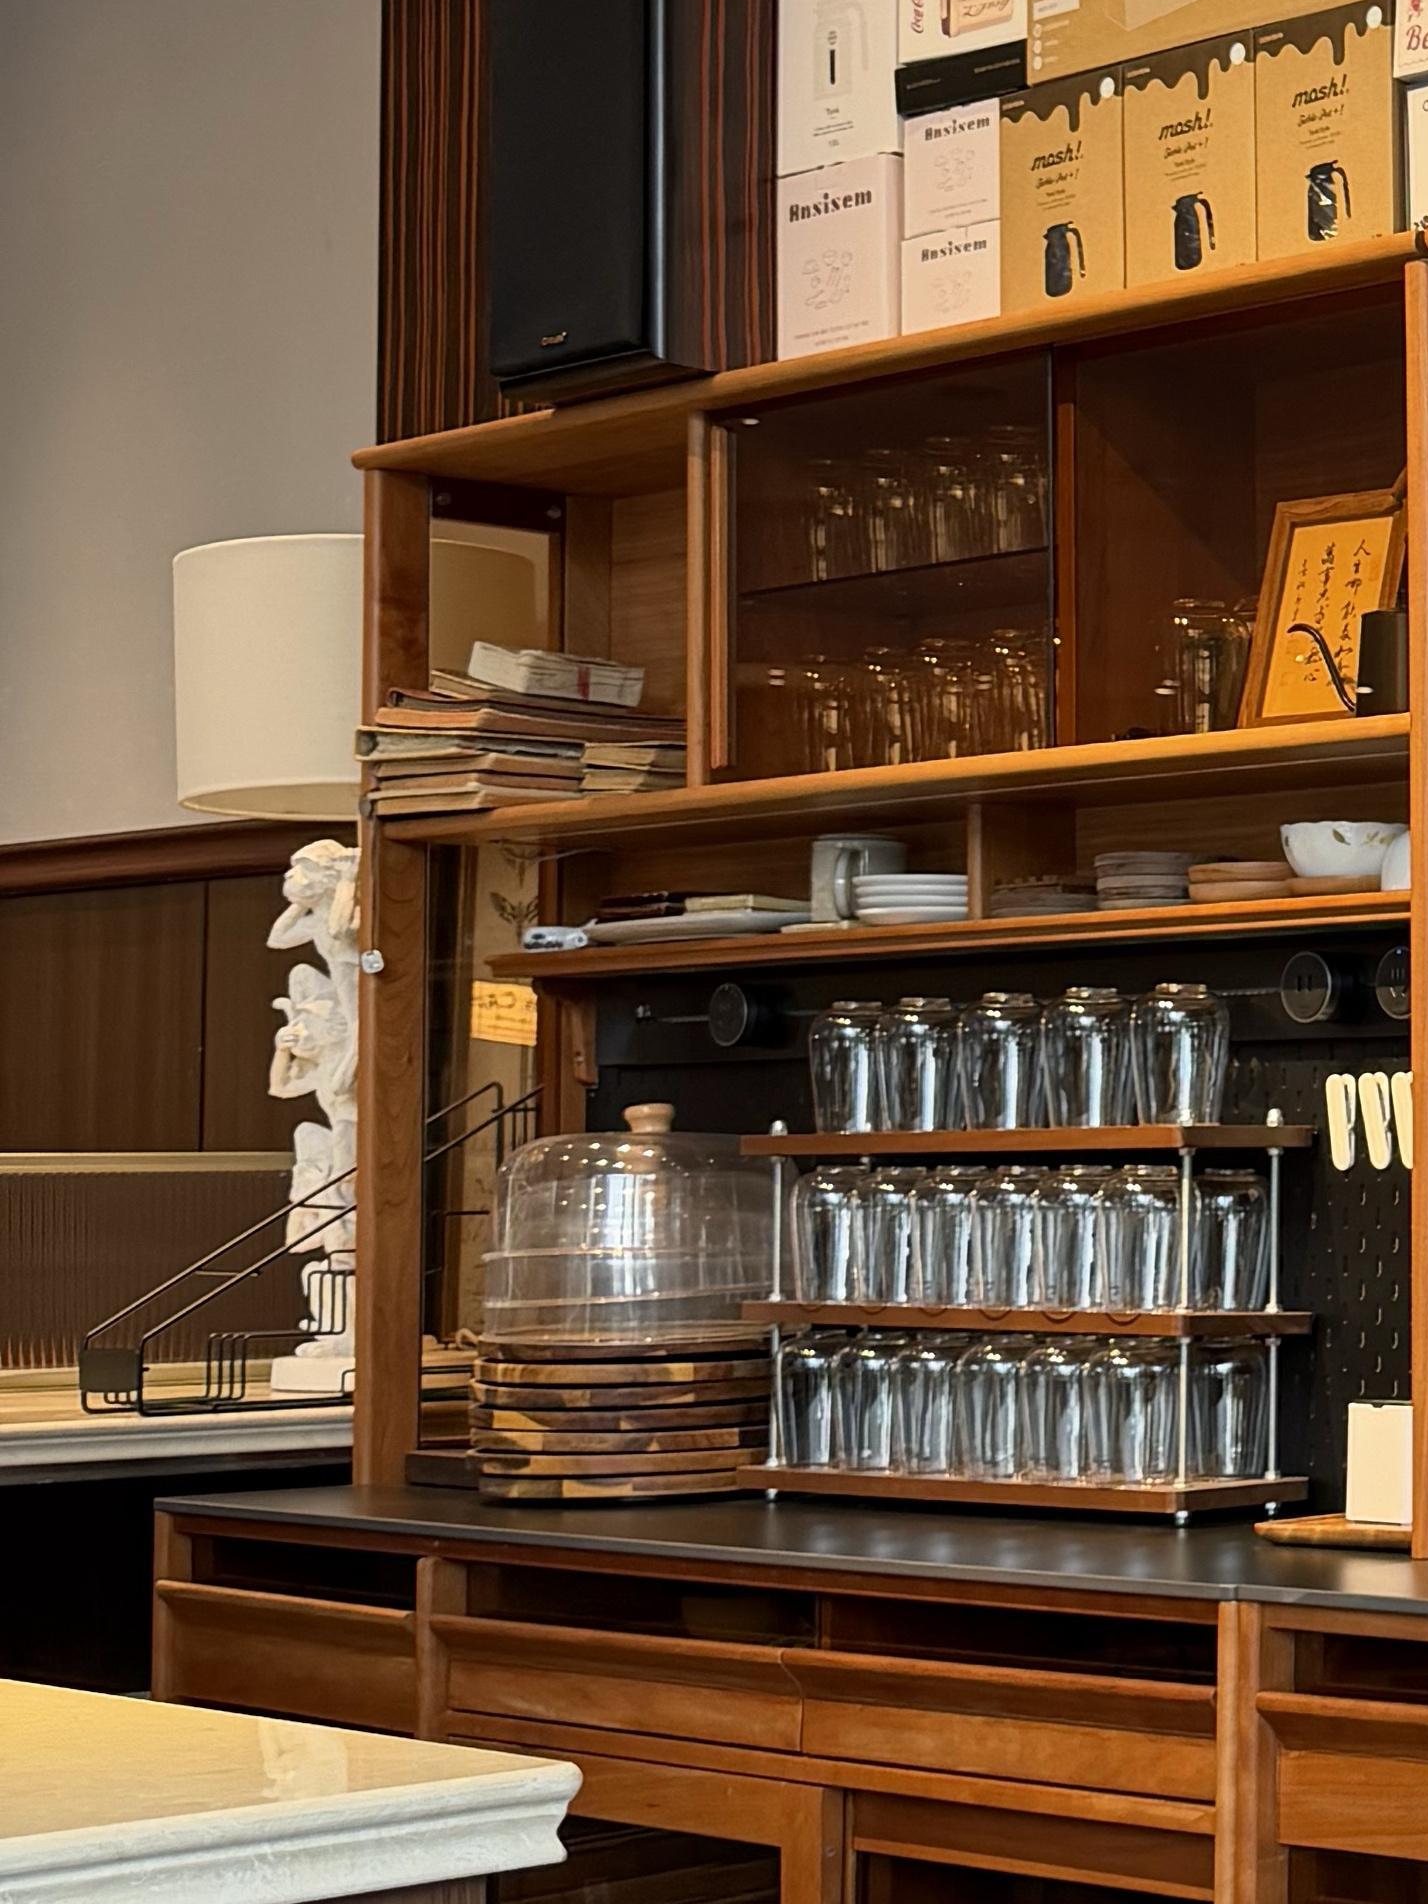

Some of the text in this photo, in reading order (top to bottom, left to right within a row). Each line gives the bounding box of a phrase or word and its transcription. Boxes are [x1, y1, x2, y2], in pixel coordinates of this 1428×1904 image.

[1291, 74, 1347, 108] mosh!
[1158, 108, 1211, 141] mosh!
[1030, 140, 1082, 172] mosh!
